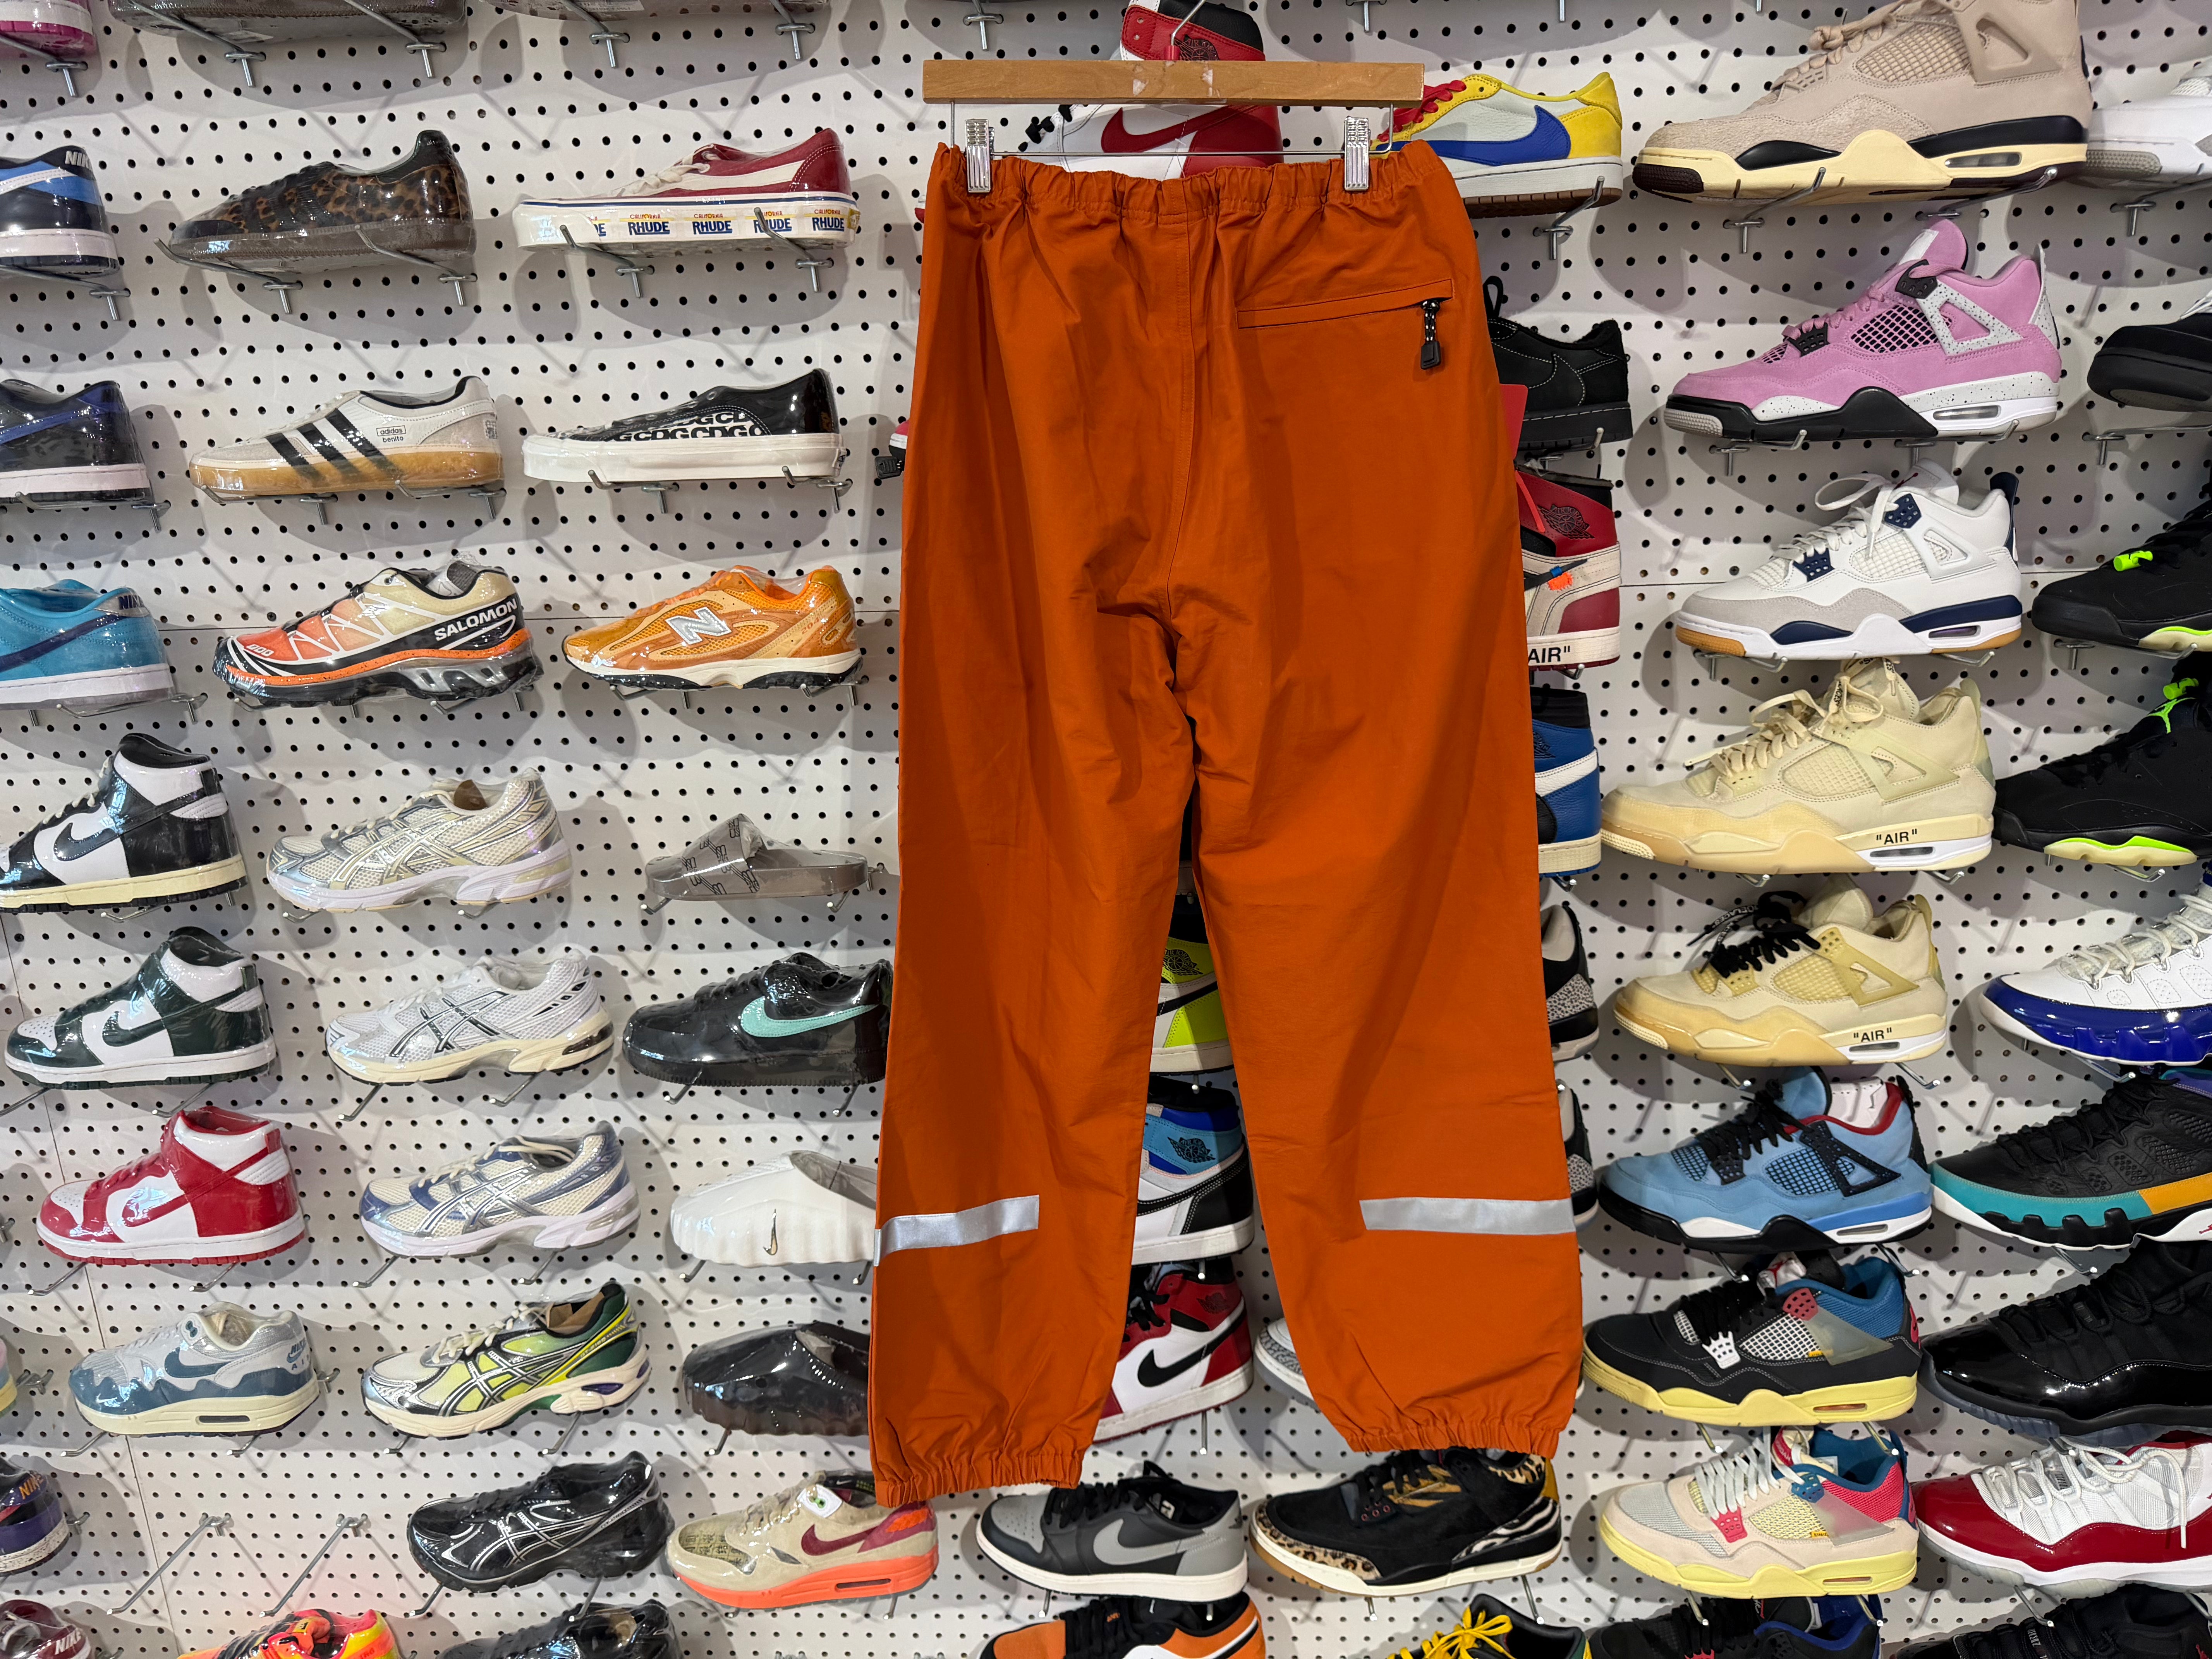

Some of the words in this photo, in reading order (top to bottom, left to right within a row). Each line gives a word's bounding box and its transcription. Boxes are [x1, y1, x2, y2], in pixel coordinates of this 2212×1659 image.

[628, 222, 670, 235] RHUDE
[692, 221, 733, 234] RHUDE
[812, 217, 844, 231] RHUDE
[434, 598, 517, 641] SALOMON
[1876, 828, 1917, 845] "AIR"
[1853, 1027, 1892, 1042] "AIR"
